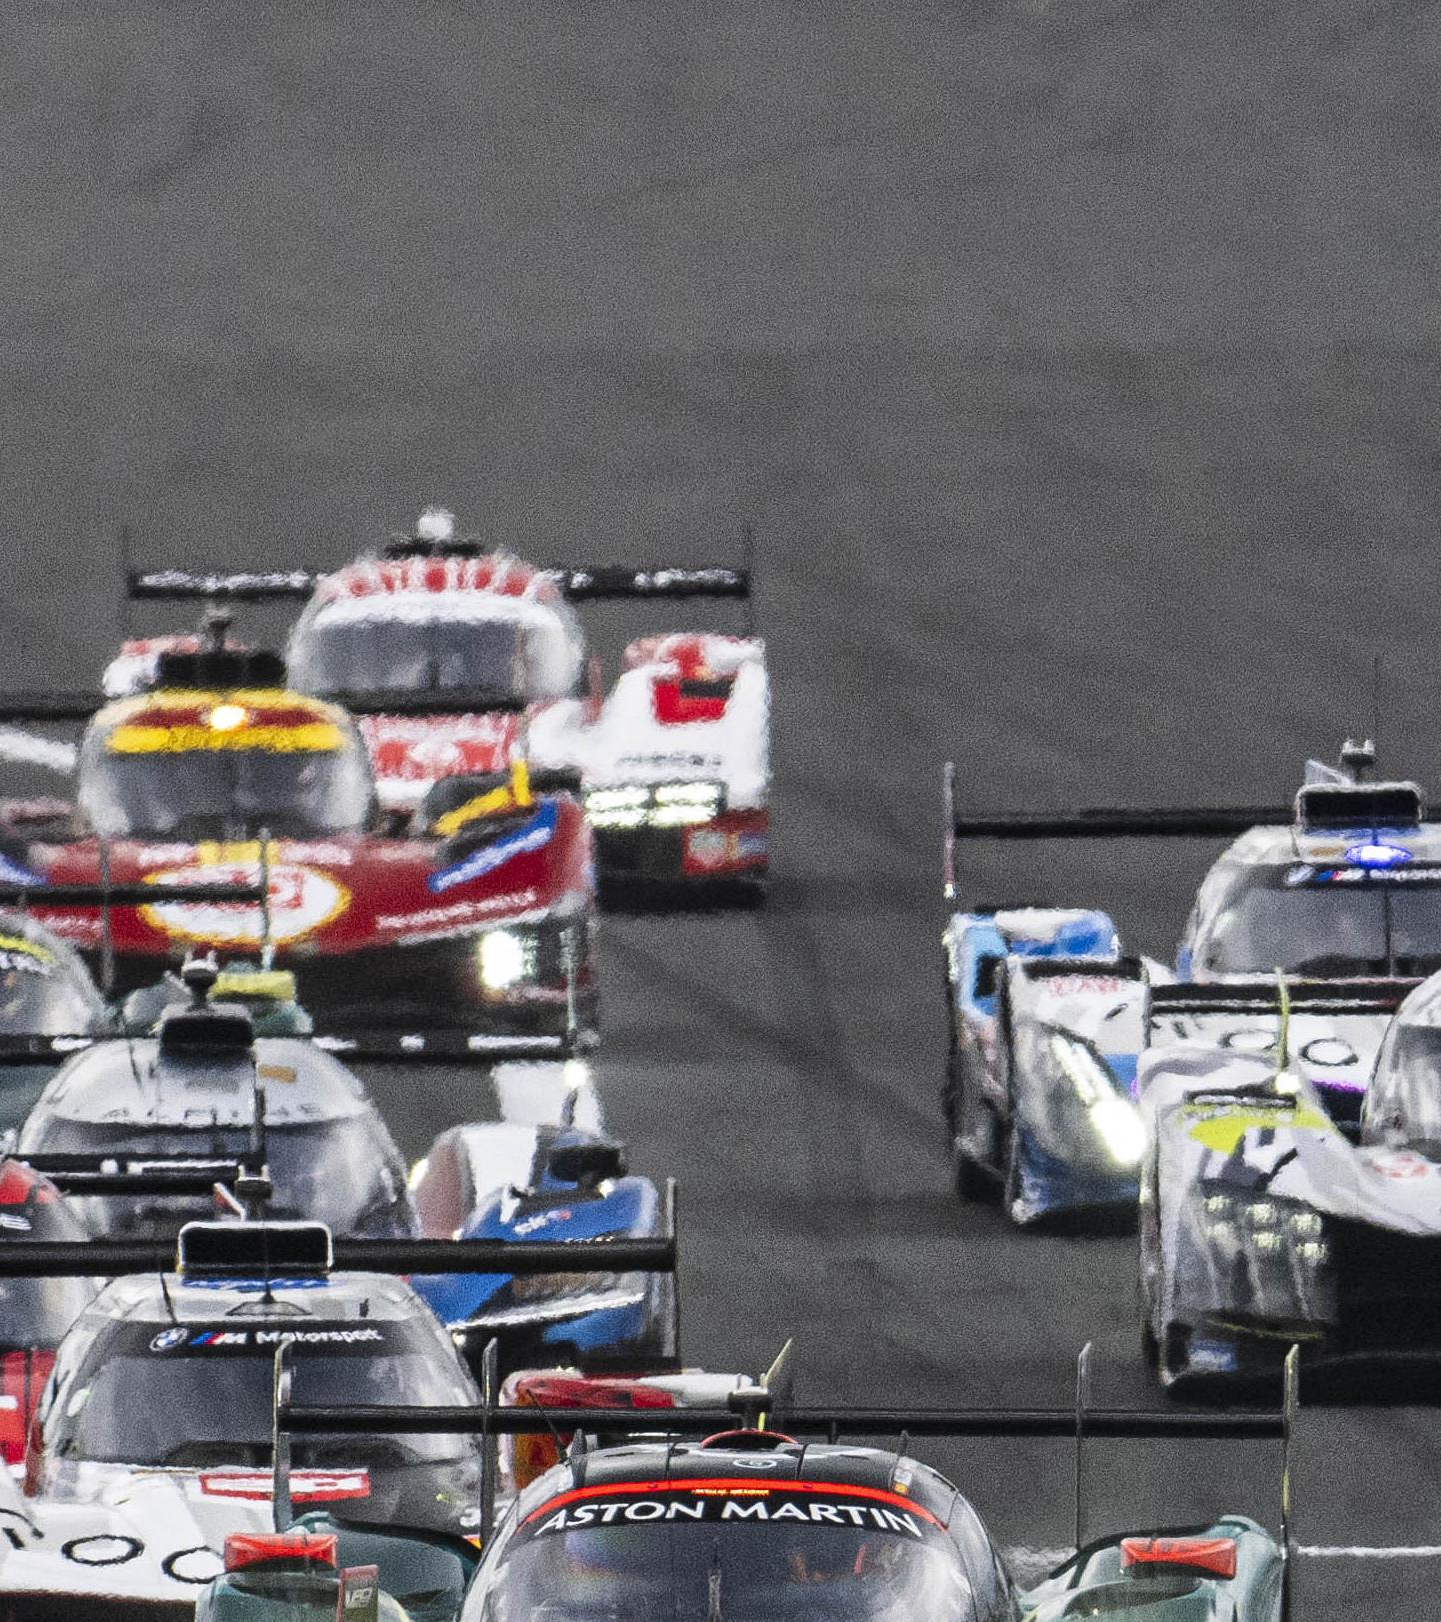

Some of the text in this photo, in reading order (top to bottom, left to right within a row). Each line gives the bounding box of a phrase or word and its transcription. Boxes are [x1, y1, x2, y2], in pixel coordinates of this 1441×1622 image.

[255, 1328, 383, 1344] Motorsport
[534, 1500, 704, 1537] ASTON
[720, 1500, 923, 1537] MARTIN
